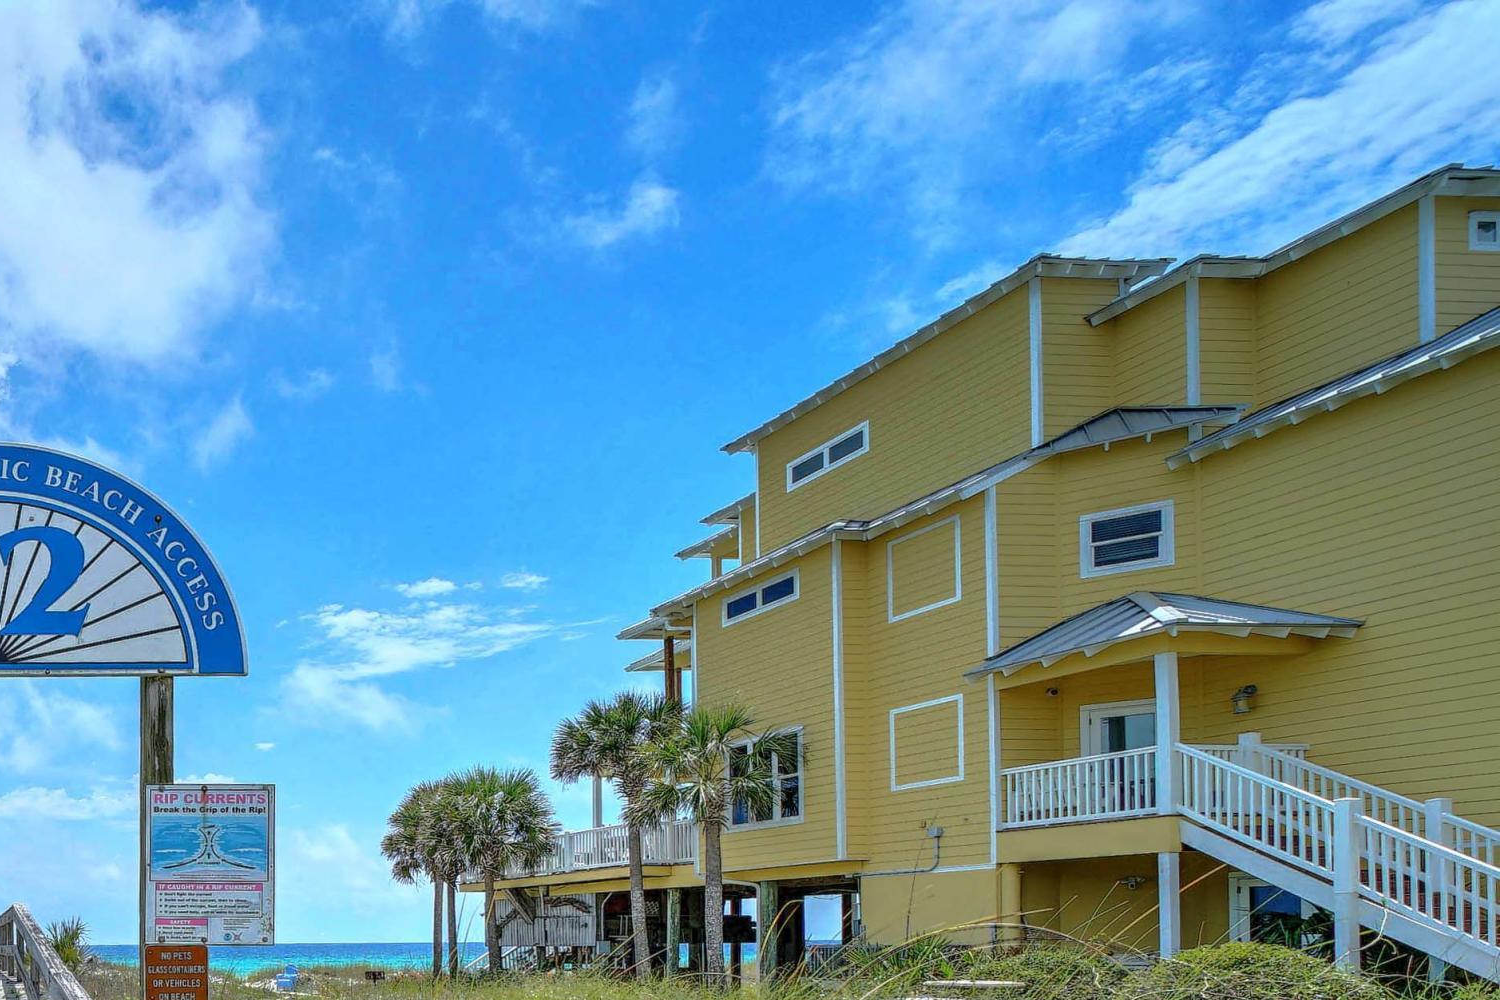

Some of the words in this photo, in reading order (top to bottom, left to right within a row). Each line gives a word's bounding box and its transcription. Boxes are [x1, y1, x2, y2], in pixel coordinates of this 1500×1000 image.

[45, 465, 144, 526] BEACH
[147, 525, 225, 631] ACCESS
[154, 794, 178, 804] RIP
[184, 793, 266, 804] CURRENTS
[161, 952, 171, 960] NO
[173, 952, 192, 960] PETS
[148, 966, 168, 974] GLASS
[169, 965, 206, 974] CONTAINERS
[165, 979, 201, 987] VEHICLES
